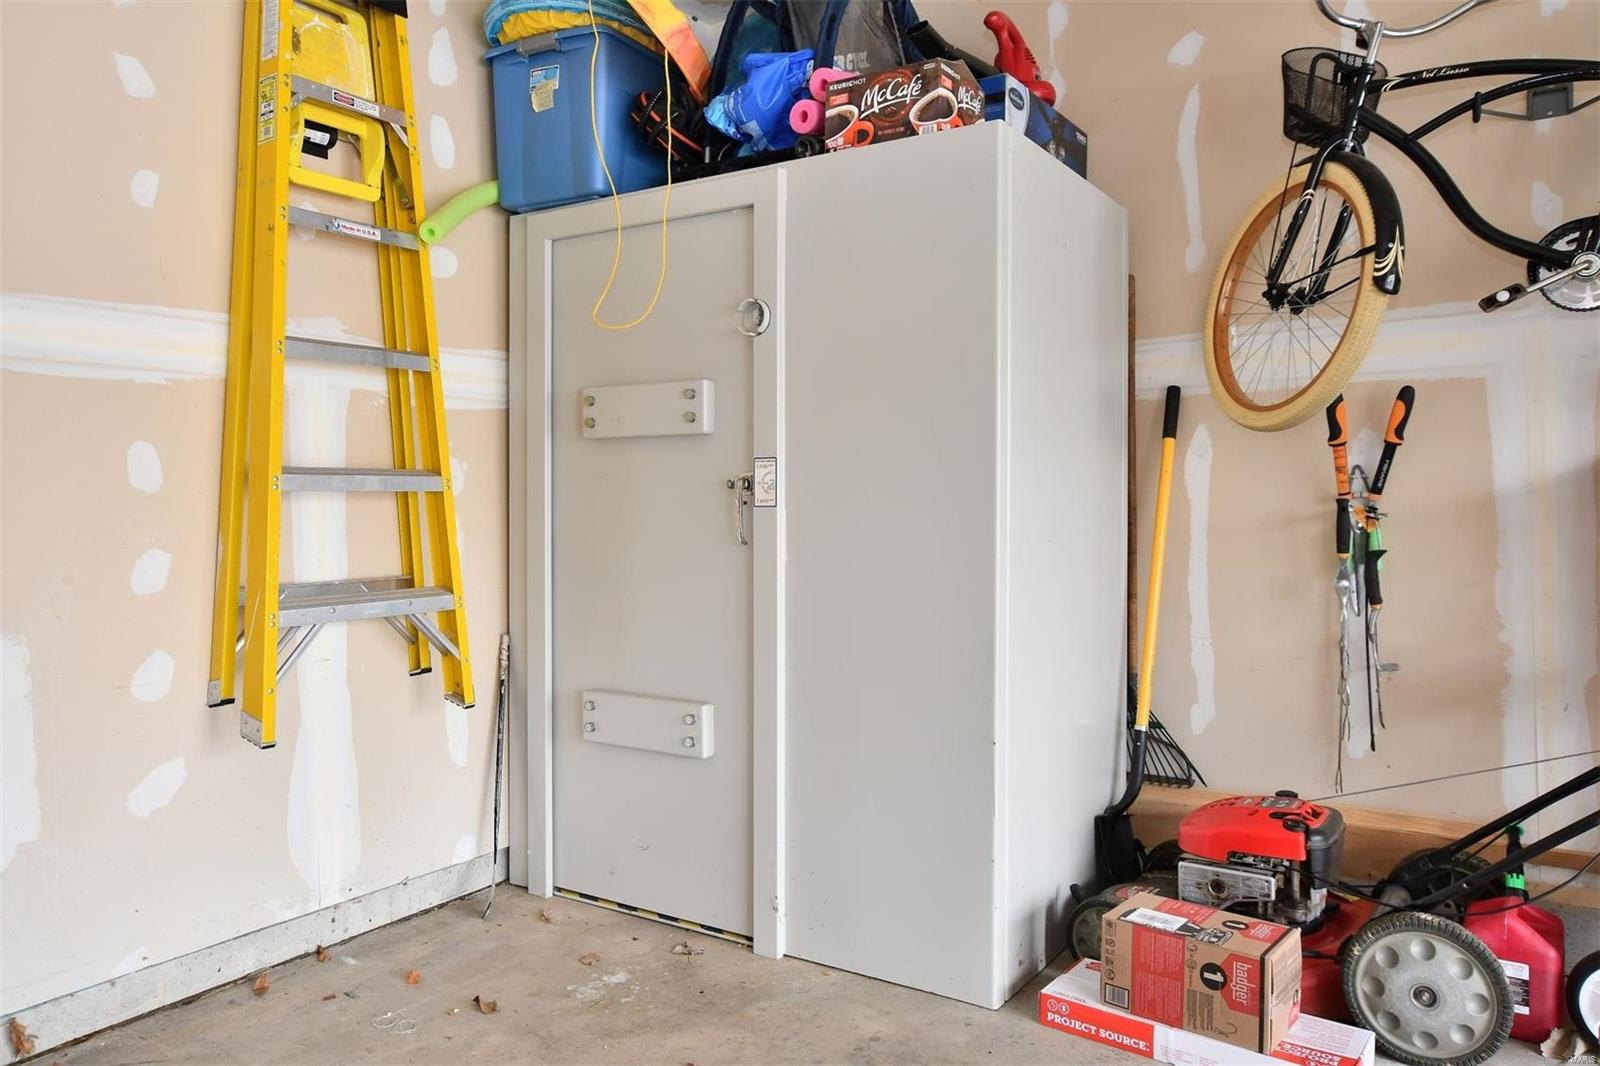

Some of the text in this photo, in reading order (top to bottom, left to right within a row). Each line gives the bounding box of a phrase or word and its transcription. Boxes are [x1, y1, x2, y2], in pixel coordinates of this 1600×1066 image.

[860, 73, 922, 113] McCafé
[1203, 971, 1224, 983] 1
[1230, 961, 1256, 1006] badger
[1047, 1012, 1097, 1034] PROJECT
